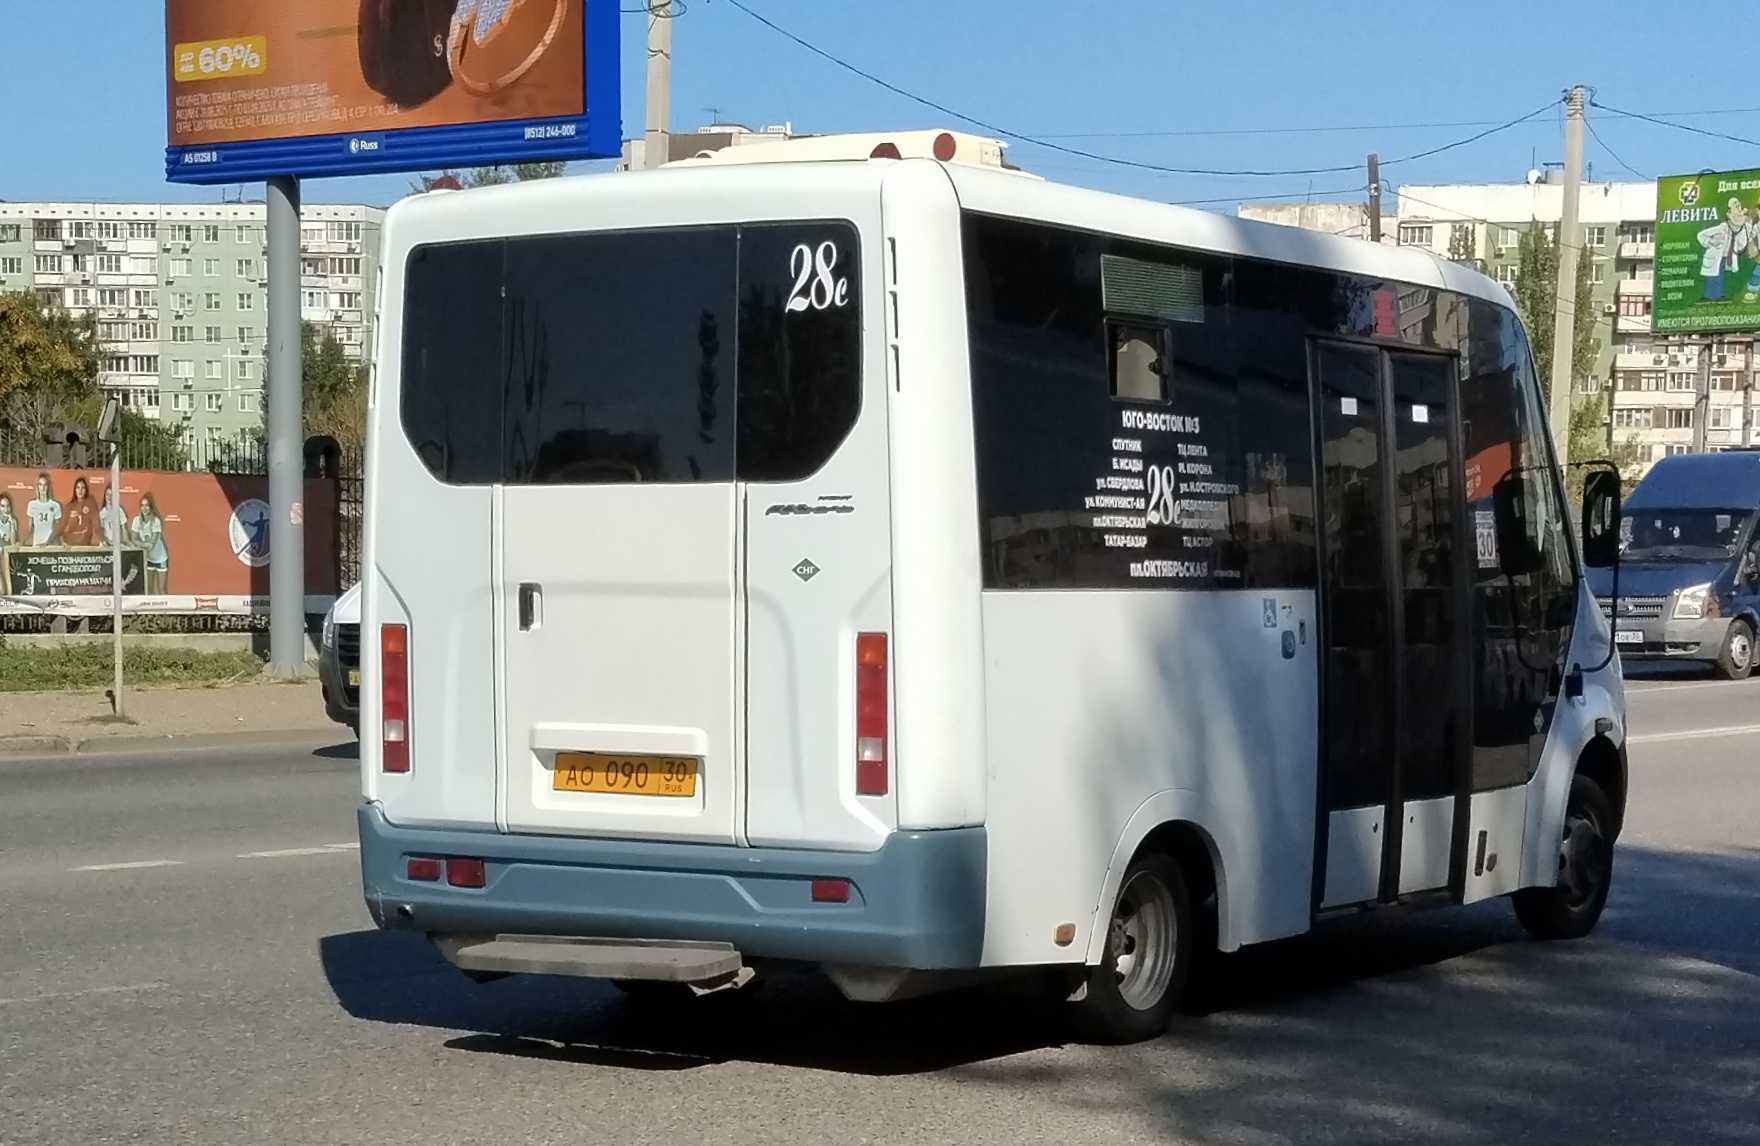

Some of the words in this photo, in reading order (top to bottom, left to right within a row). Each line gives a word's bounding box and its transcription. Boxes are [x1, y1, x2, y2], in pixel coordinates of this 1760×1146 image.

[546, 125, 576, 137] 246-000
[360, 140, 379, 151] Russ
[1717, 181, 1738, 194] Для
[1660, 206, 1719, 224] ЛЕВИТА
[1657, 317, 1690, 328] ИМЕЮТСЯ
[1121, 410, 1184, 433] ЮГО-ВОСТОК
[1112, 438, 1142, 452] СПУТНИК
[39, 512, 48, 523] 34
[1103, 534, 1148, 548] ТАТАР-БАЗАР
[27, 556, 58, 565] ХОЧЕШЬ
[796, 565, 815, 575] СНГ
[45, 578, 80, 587] ПРИХОДИ
[565, 765, 594, 786] АО
[605, 761, 649, 788] 090
[663, 761, 687, 783] 30
[665, 784, 683, 793] RUS
